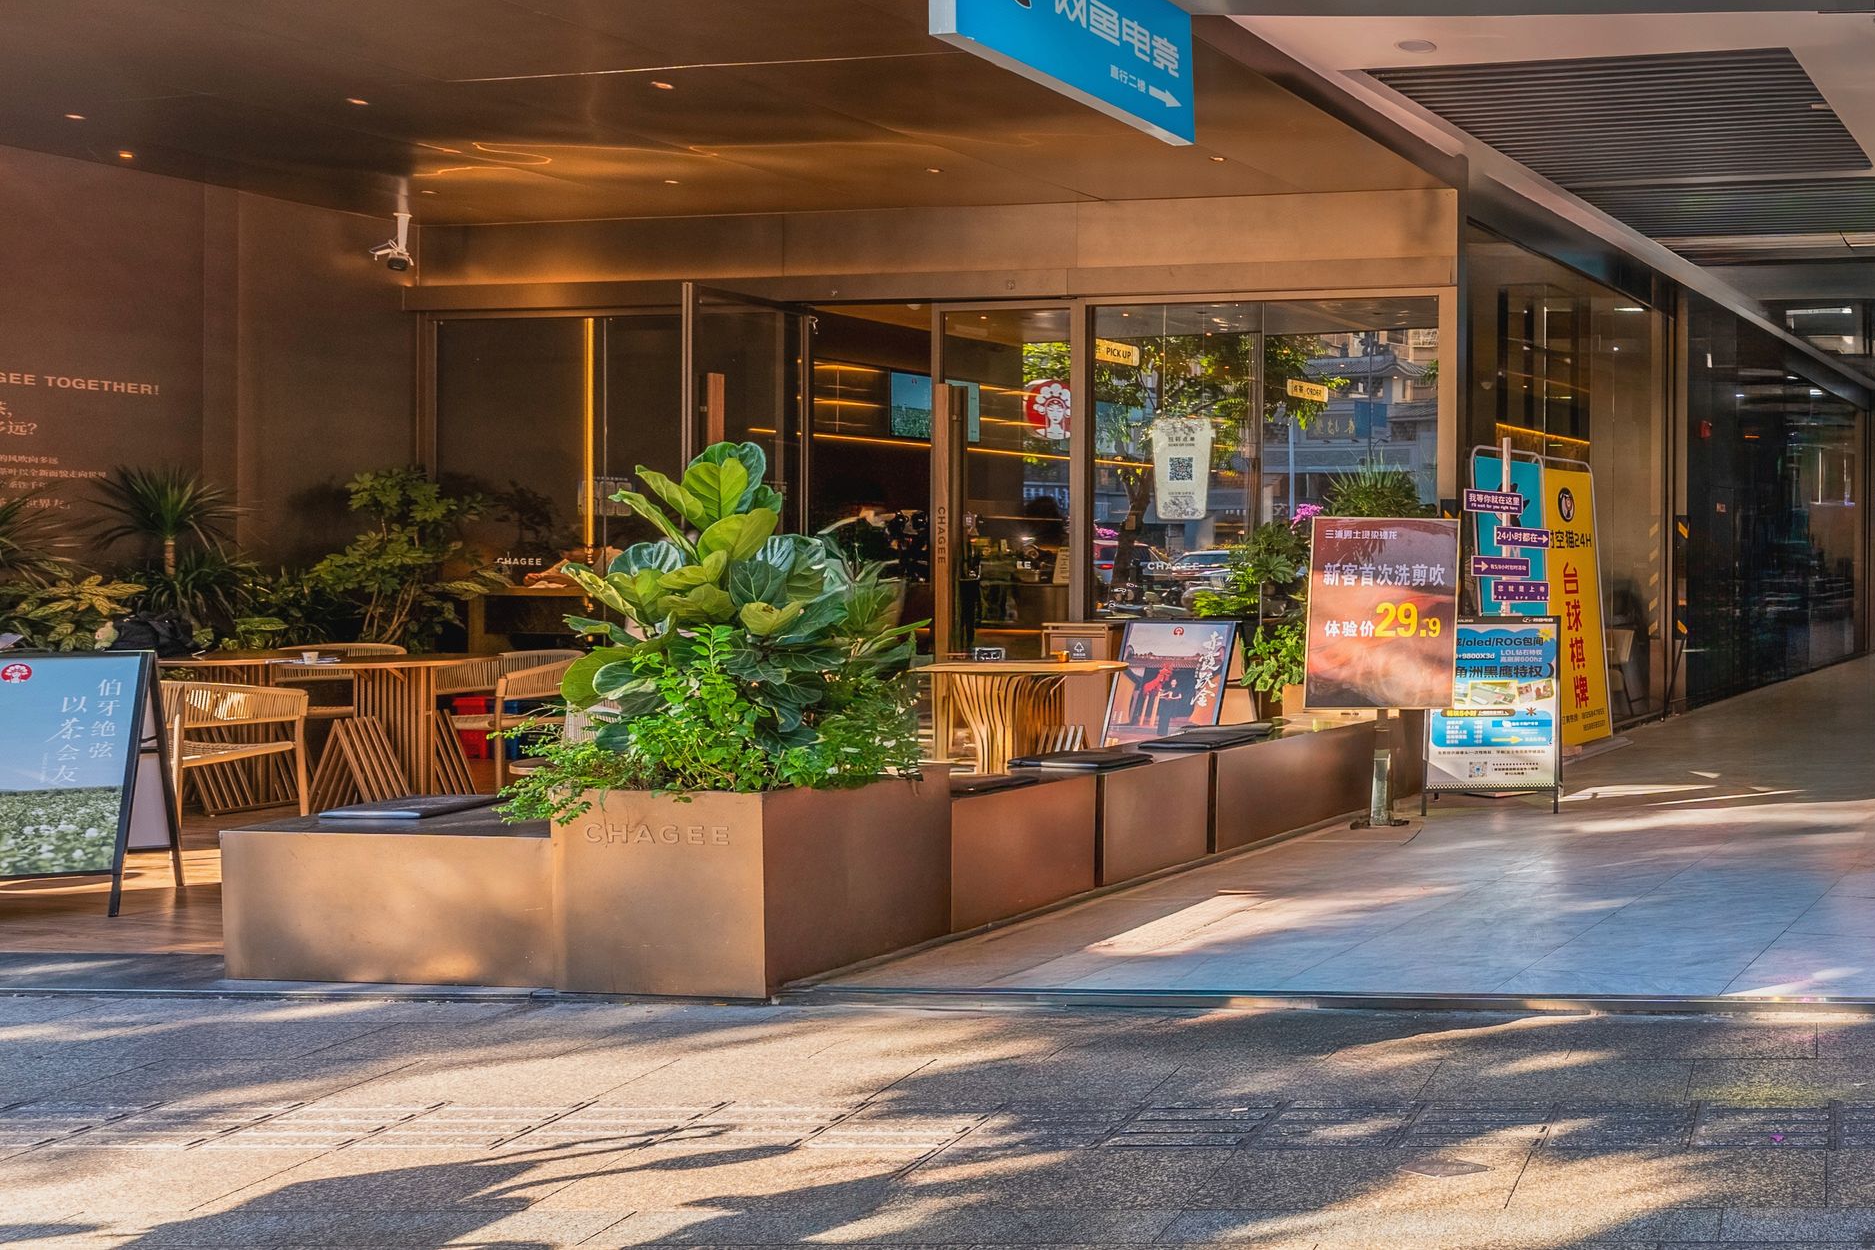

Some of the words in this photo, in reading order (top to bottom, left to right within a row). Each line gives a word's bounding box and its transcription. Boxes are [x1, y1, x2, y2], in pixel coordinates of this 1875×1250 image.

[1110, 64, 1146, 94] 直行二楼
[44, 376, 160, 396] TOGETHER!
[1469, 493, 1520, 505] 我等你就在这里
[937, 506, 946, 564] CHAGEE
[1497, 531, 1538, 543] 24小时都在
[497, 557, 542, 566] CHAGEE
[1323, 562, 1446, 587] 新客首次洗剪吹
[1563, 562, 1590, 709] 台球棋牌
[89, 678, 122, 759] 伯牙绝弦
[45, 696, 87, 783] 以茶会友
[585, 821, 730, 846] CHAGEE
